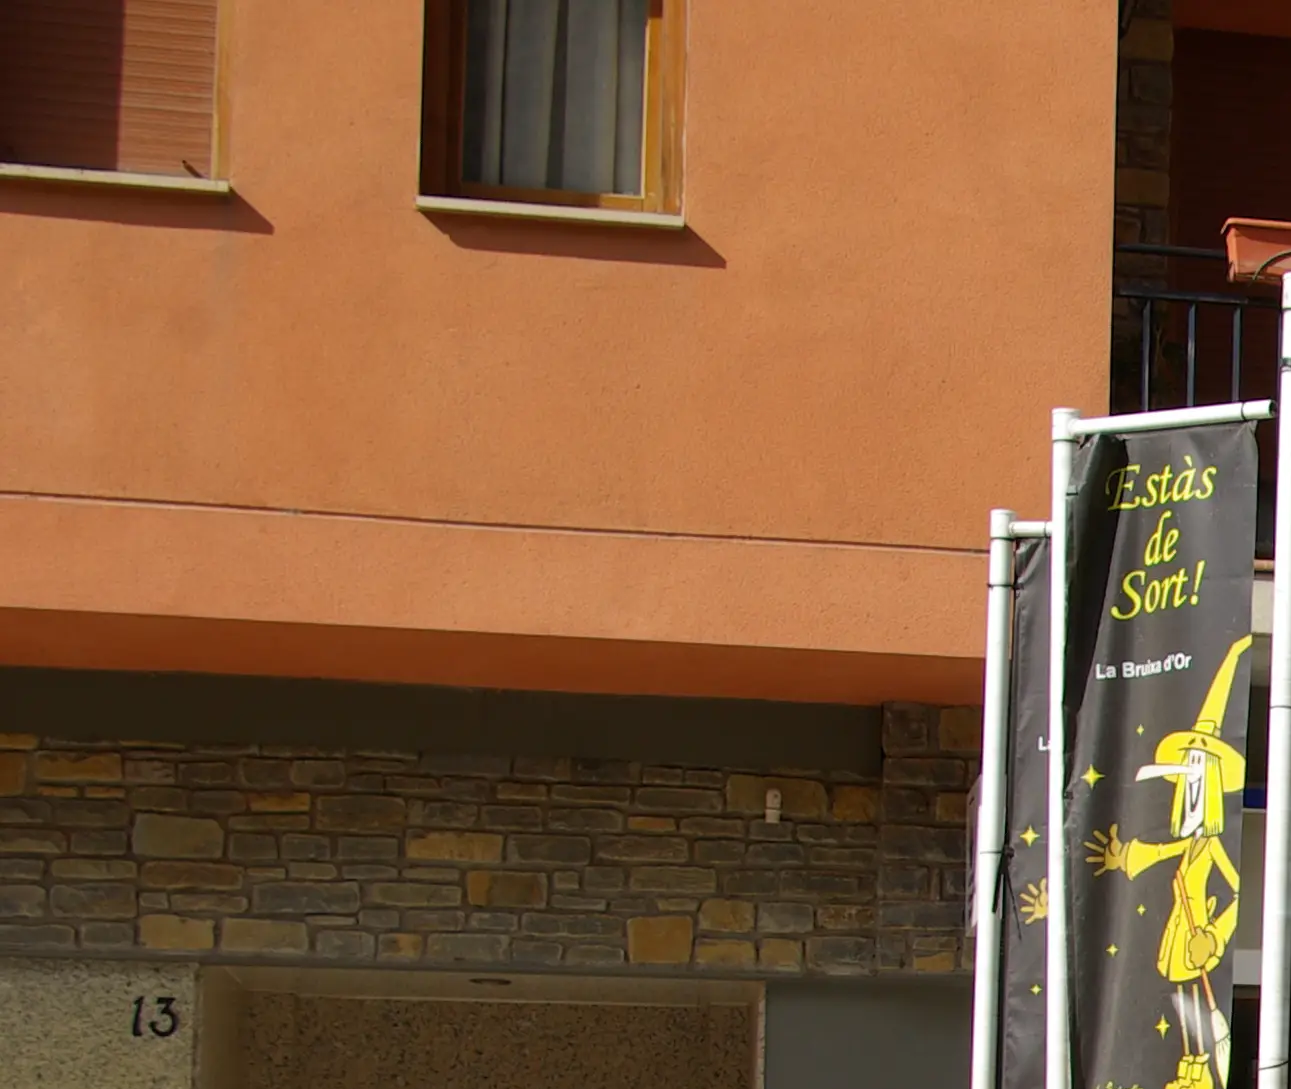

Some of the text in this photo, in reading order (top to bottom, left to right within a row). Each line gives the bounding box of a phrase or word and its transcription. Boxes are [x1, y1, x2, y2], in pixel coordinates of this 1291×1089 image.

[1105, 455, 1217, 511] Estàs
[1144, 510, 1179, 566] de
[1110, 560, 1206, 620] Sort!
[1095, 653, 1192, 680] La Bruixa d'Or
[130, 996, 180, 1038] 13
